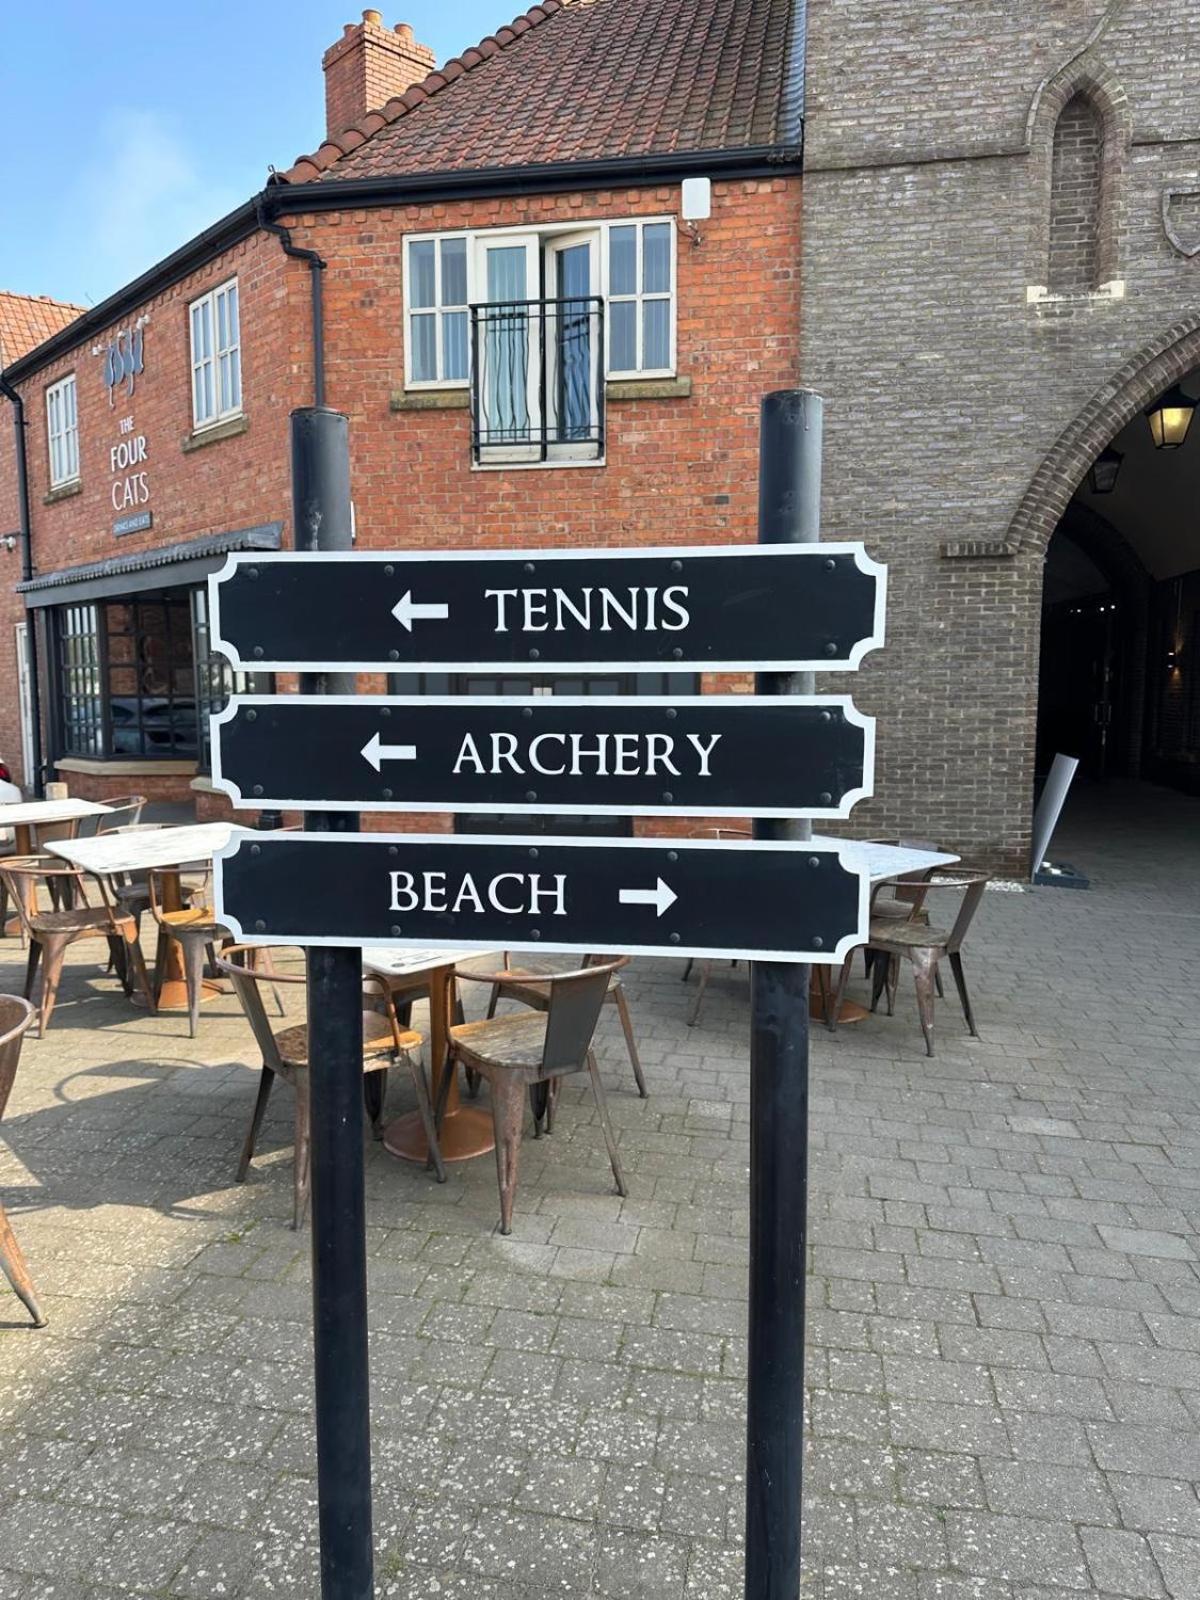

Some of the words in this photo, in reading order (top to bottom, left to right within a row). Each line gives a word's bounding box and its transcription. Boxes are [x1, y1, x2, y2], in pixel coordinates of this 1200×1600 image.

[119, 415, 135, 434] THE
[110, 435, 147, 472] FOUR
[111, 471, 148, 511] CATS
[485, 586, 690, 632] TENNIS
[453, 733, 722, 776] ARCHERY
[389, 872, 567, 915] BEACH
